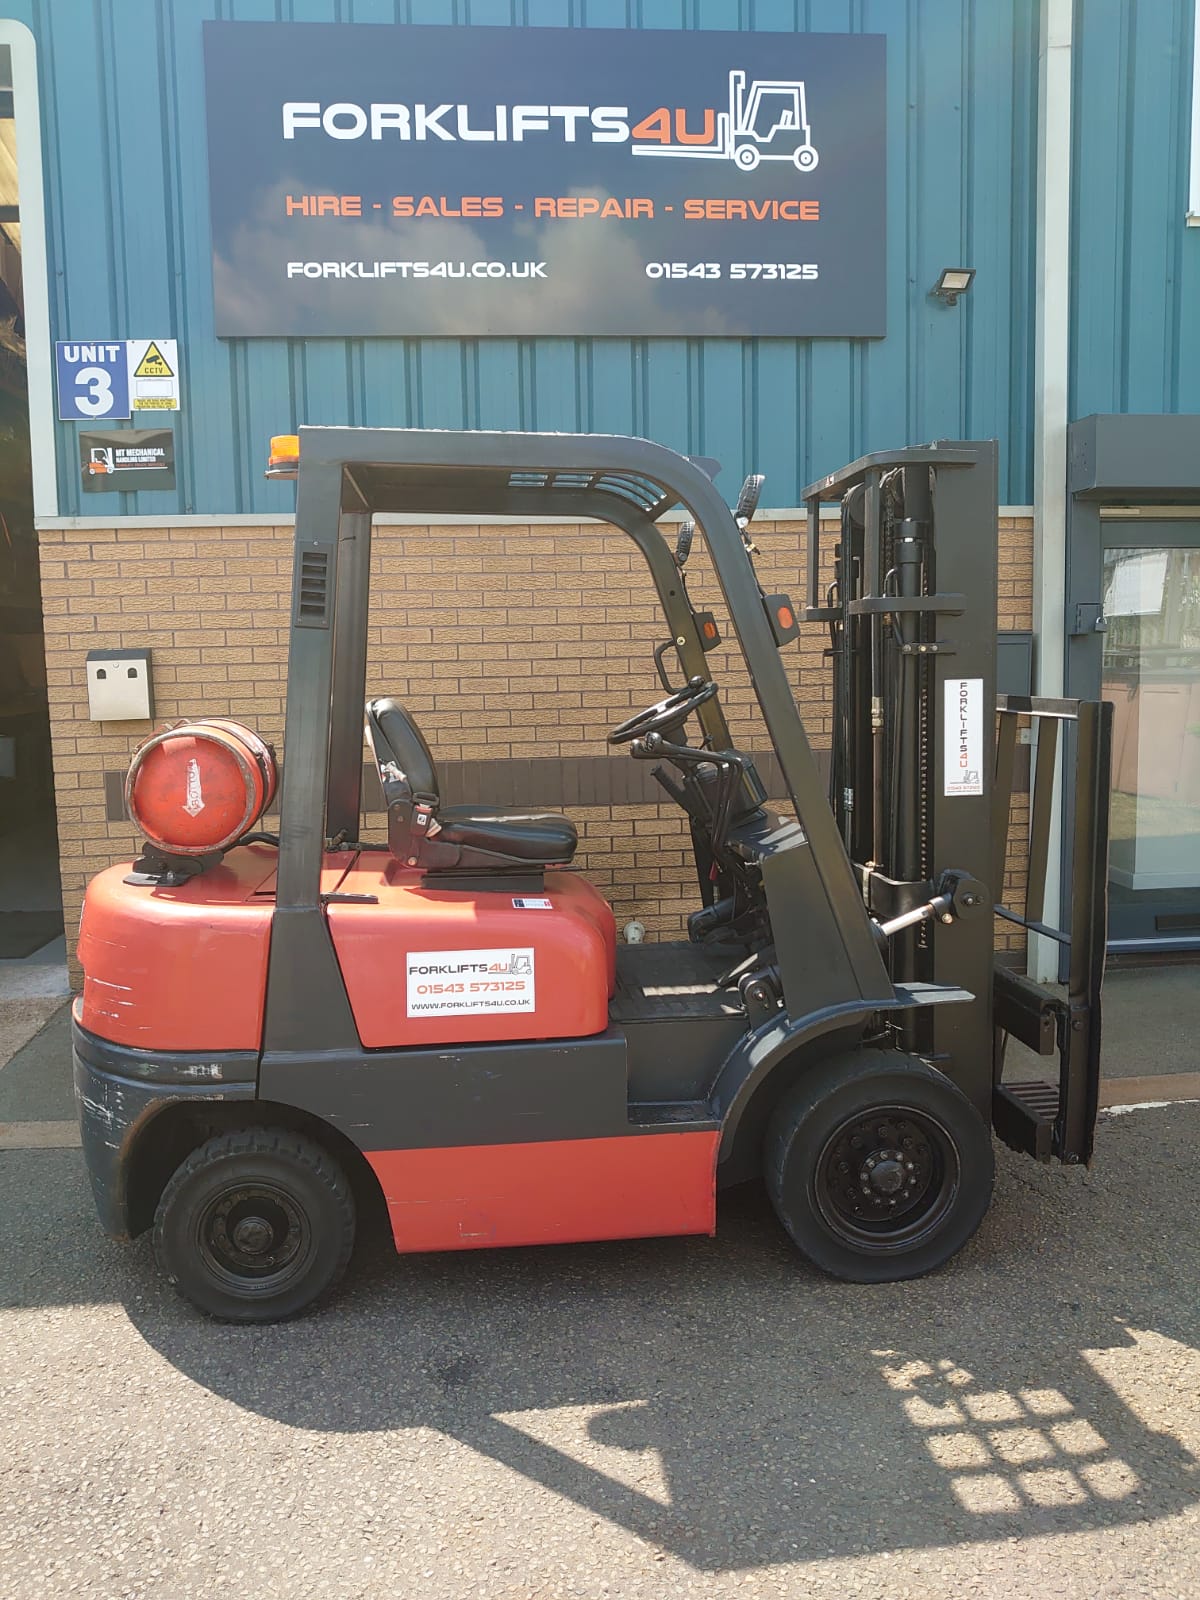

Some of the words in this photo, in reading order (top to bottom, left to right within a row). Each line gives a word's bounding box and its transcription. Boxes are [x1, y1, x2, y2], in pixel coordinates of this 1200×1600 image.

[283, 102, 715, 144] FORKLIFTS4U
[286, 195, 362, 217] HIRE
[392, 196, 504, 218] SALES
[534, 197, 655, 219] REPAIR
[684, 199, 820, 221] SERVICE
[287, 262, 548, 279] FORKLIFTS4U.CO.UK
[645, 263, 721, 279] 01543
[729, 264, 819, 280] 573125
[63, 344, 121, 363] UNIT
[74, 366, 114, 417] 3
[126, 447, 165, 457] MECHANICAL
[959, 681, 968, 768] FORKLIFTS4U
[409, 963, 508, 976] FORKLIFTS4U
[417, 984, 465, 995] 01543
[470, 981, 526, 993] 573125
[411, 999, 531, 1010] WWW.FORKLIFTS4U.CO.UK
